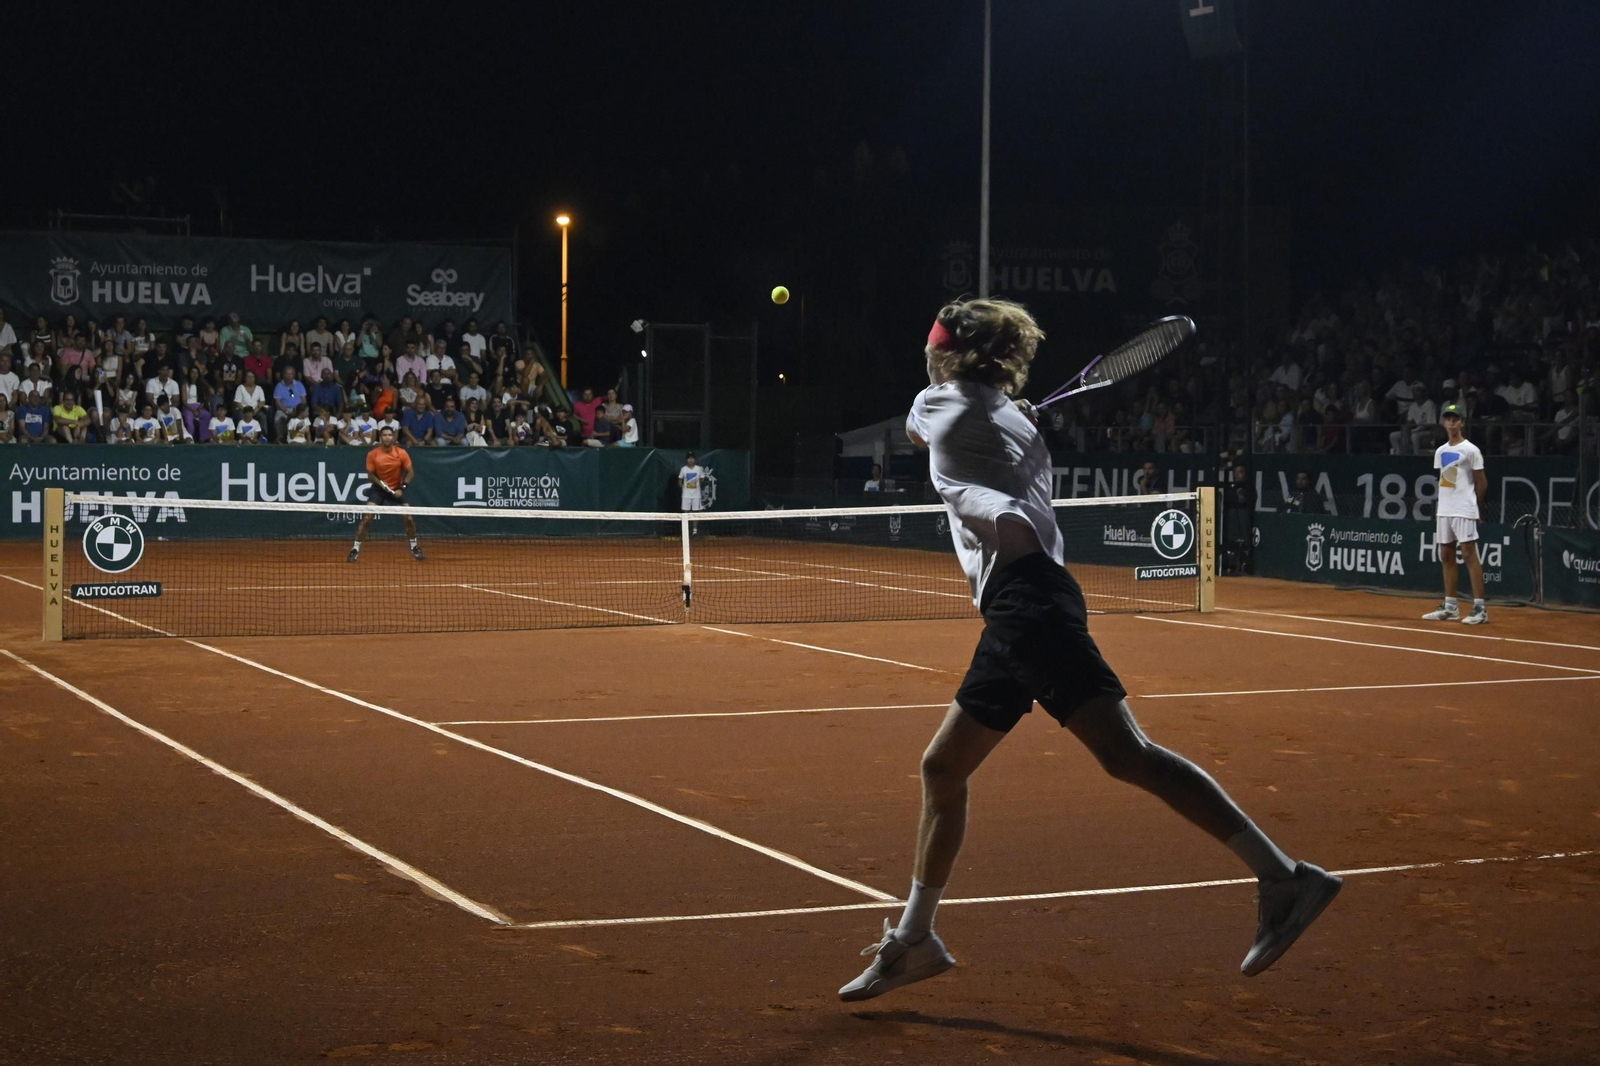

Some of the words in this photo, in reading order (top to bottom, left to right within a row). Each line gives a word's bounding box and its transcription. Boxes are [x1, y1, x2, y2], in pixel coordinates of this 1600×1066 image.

[90, 261, 188, 277] Ayuntamiento
[191, 264, 209, 277] de
[251, 264, 361, 294] Huelva
[988, 266, 1117, 293] HUELVA
[91, 280, 212, 305] HUELVA
[406, 282, 485, 312] Seabery
[323, 299, 361, 309] original
[9, 463, 151, 485] Ayuntamiento
[157, 463, 181, 481] de
[488, 473, 560, 488] DIPUTACIÓN
[488, 489, 503, 498] DE
[509, 488, 559, 498] HUELVA
[488, 498, 533, 507] OBJETIVOS
[92, 516, 137, 533] BMW
[1158, 512, 1189, 527] BMW
[1104, 524, 1137, 542] Huelva
[1330, 528, 1388, 543] Ayuntamiento
[1391, 531, 1403, 544] de
[50, 525, 59, 605] HUELVA
[1329, 547, 1405, 575] HUELVA
[1140, 566, 1197, 578] AUTOGOTRAN
[76, 584, 157, 597] AUTOGOTRAN
